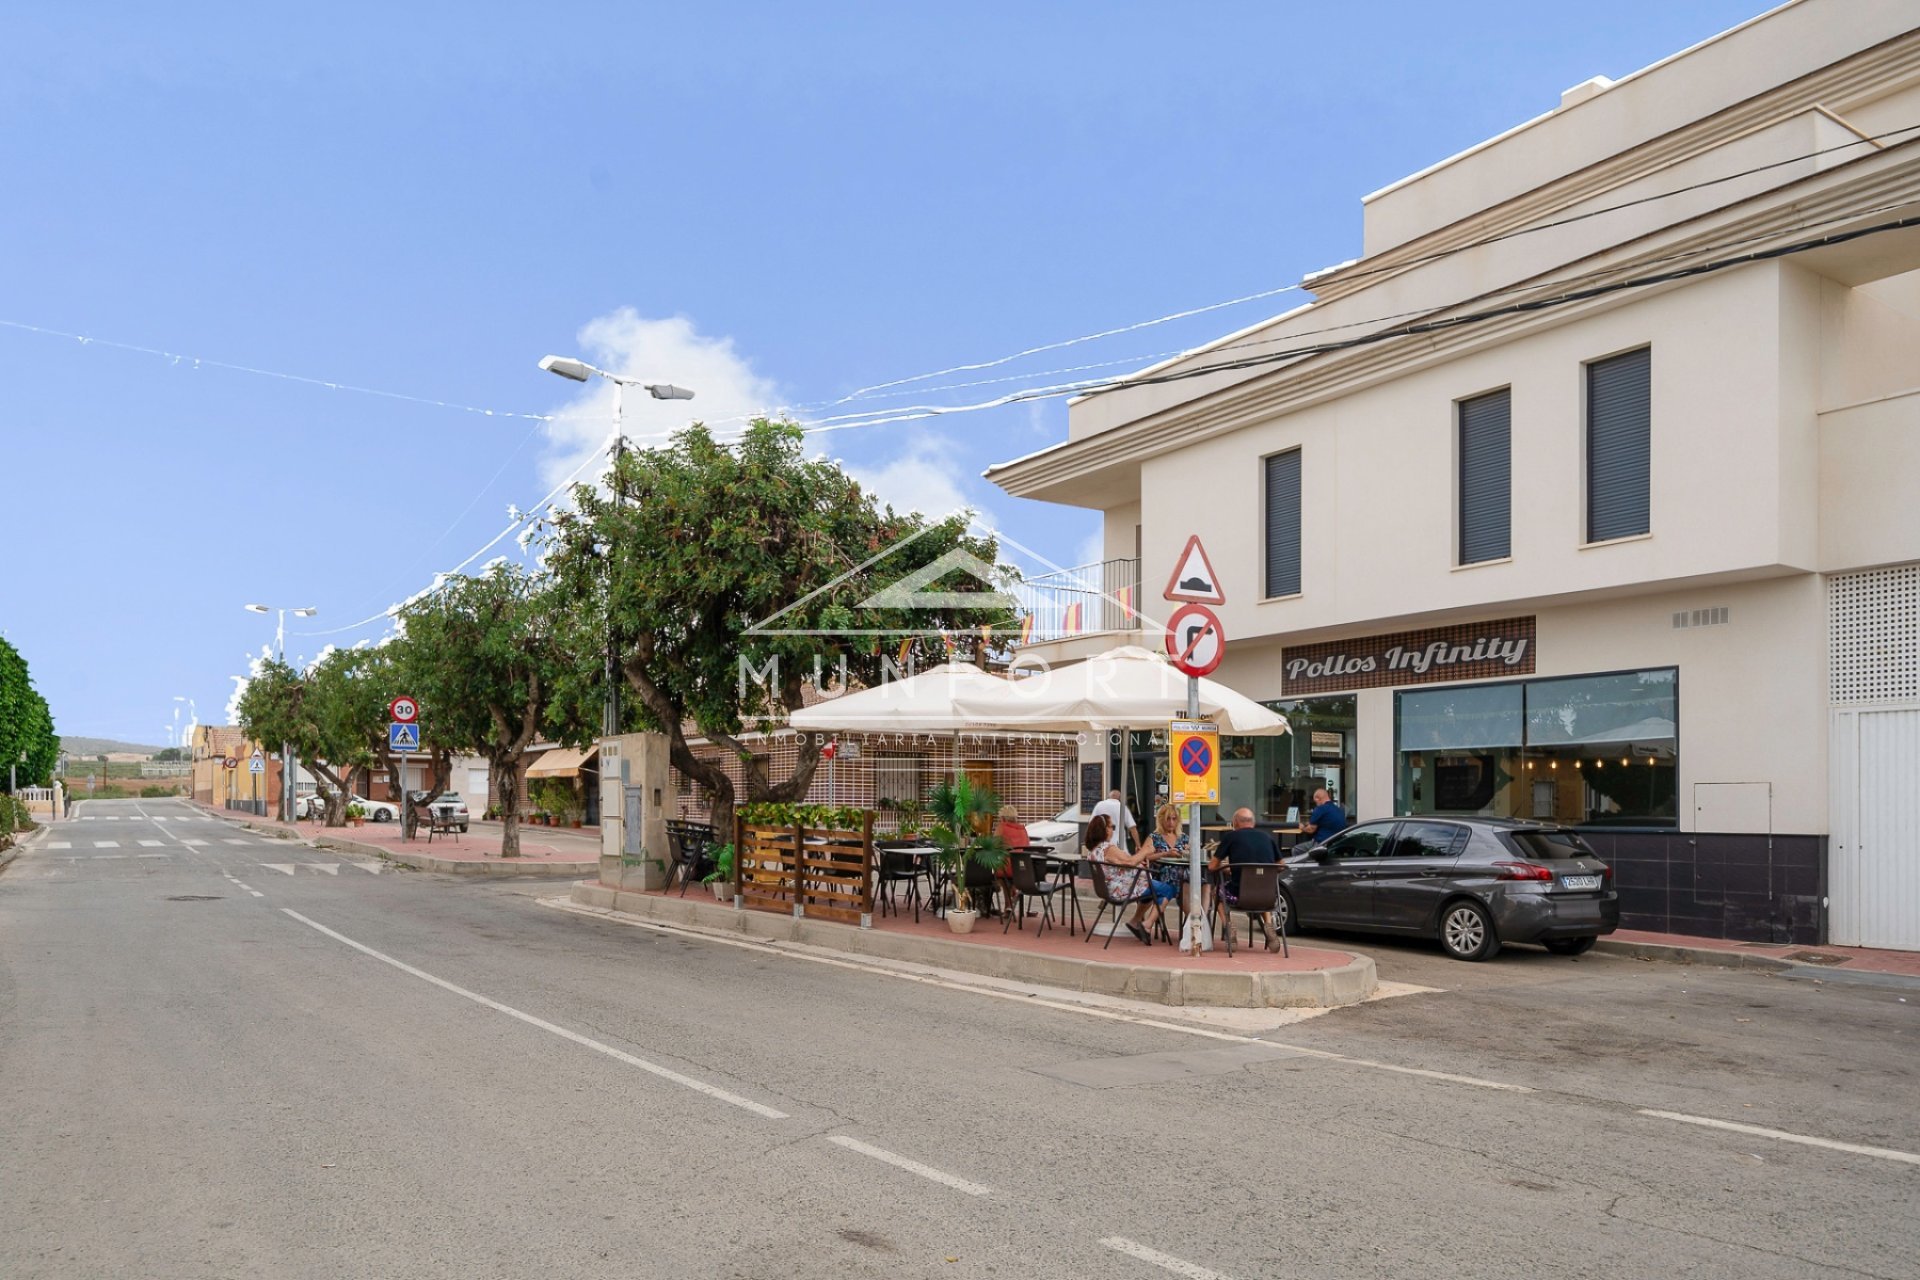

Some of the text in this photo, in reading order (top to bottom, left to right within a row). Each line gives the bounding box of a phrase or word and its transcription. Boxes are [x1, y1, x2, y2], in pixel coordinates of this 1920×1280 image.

[1286, 637, 1527, 680] Pollos Infinity
[396, 705, 413, 715] 30
